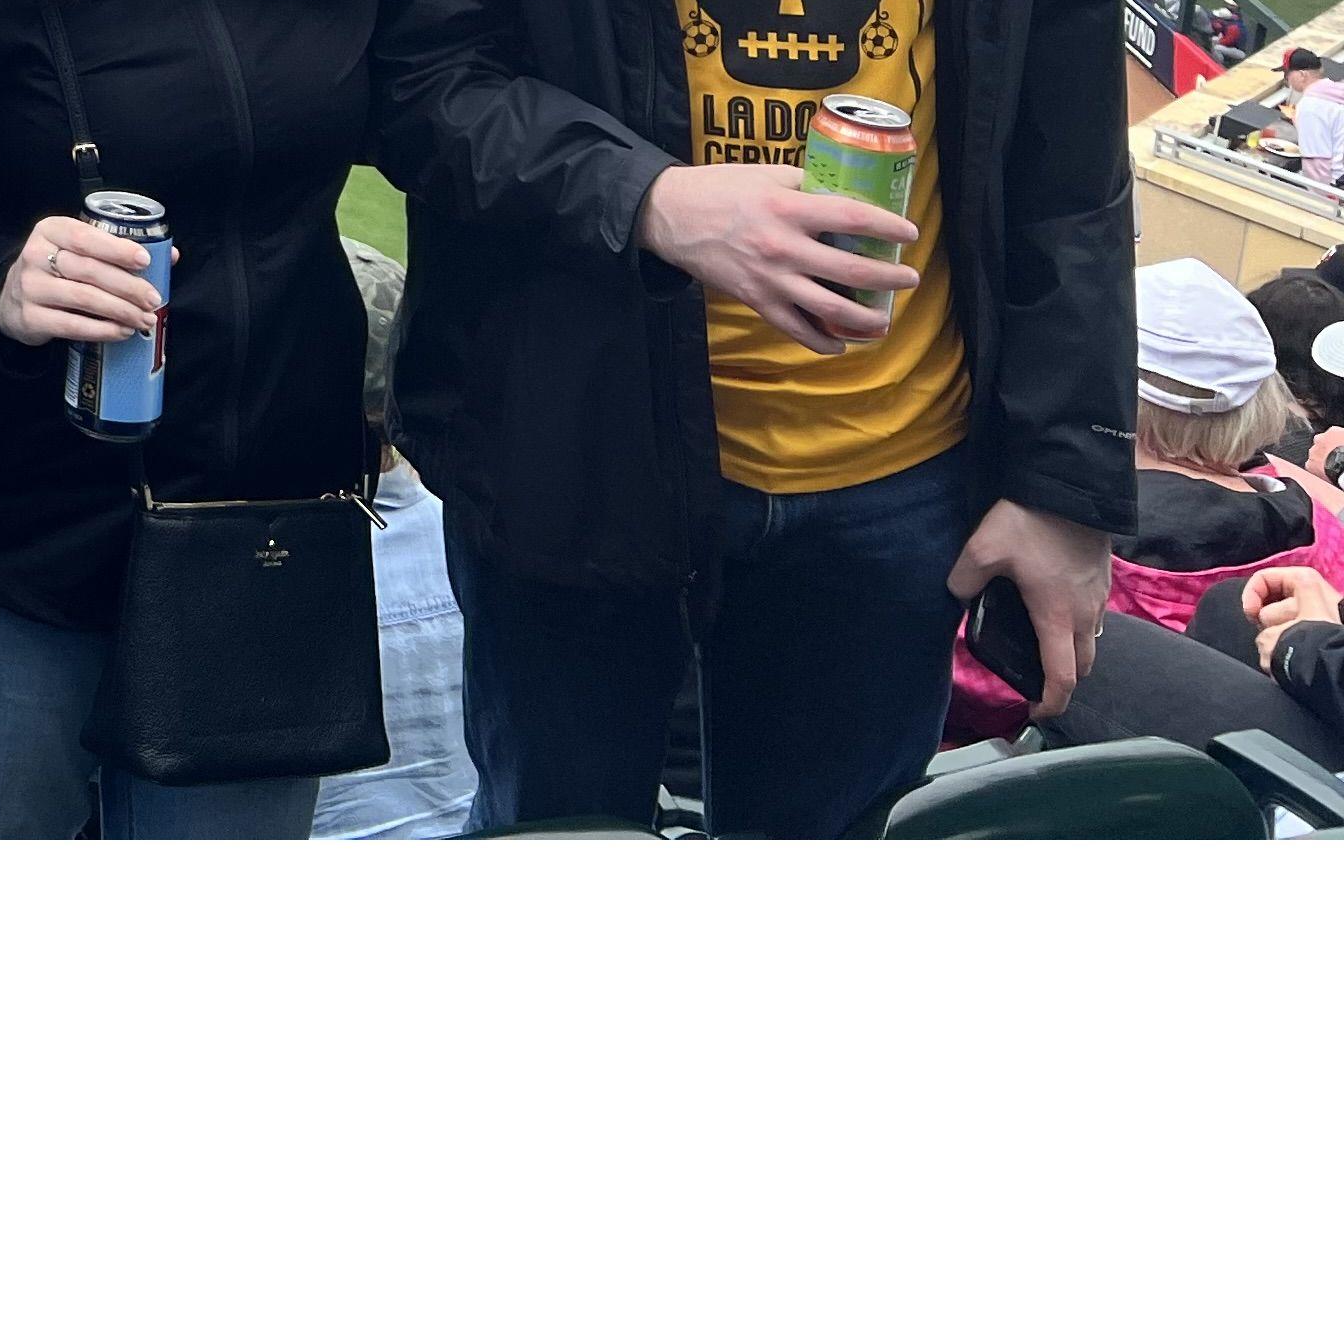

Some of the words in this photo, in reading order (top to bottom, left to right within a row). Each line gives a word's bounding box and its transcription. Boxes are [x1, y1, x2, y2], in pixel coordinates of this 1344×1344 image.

[1124, 6, 1156, 56] FUND
[703, 94, 755, 141] LA
[764, 99, 818, 141] DO
